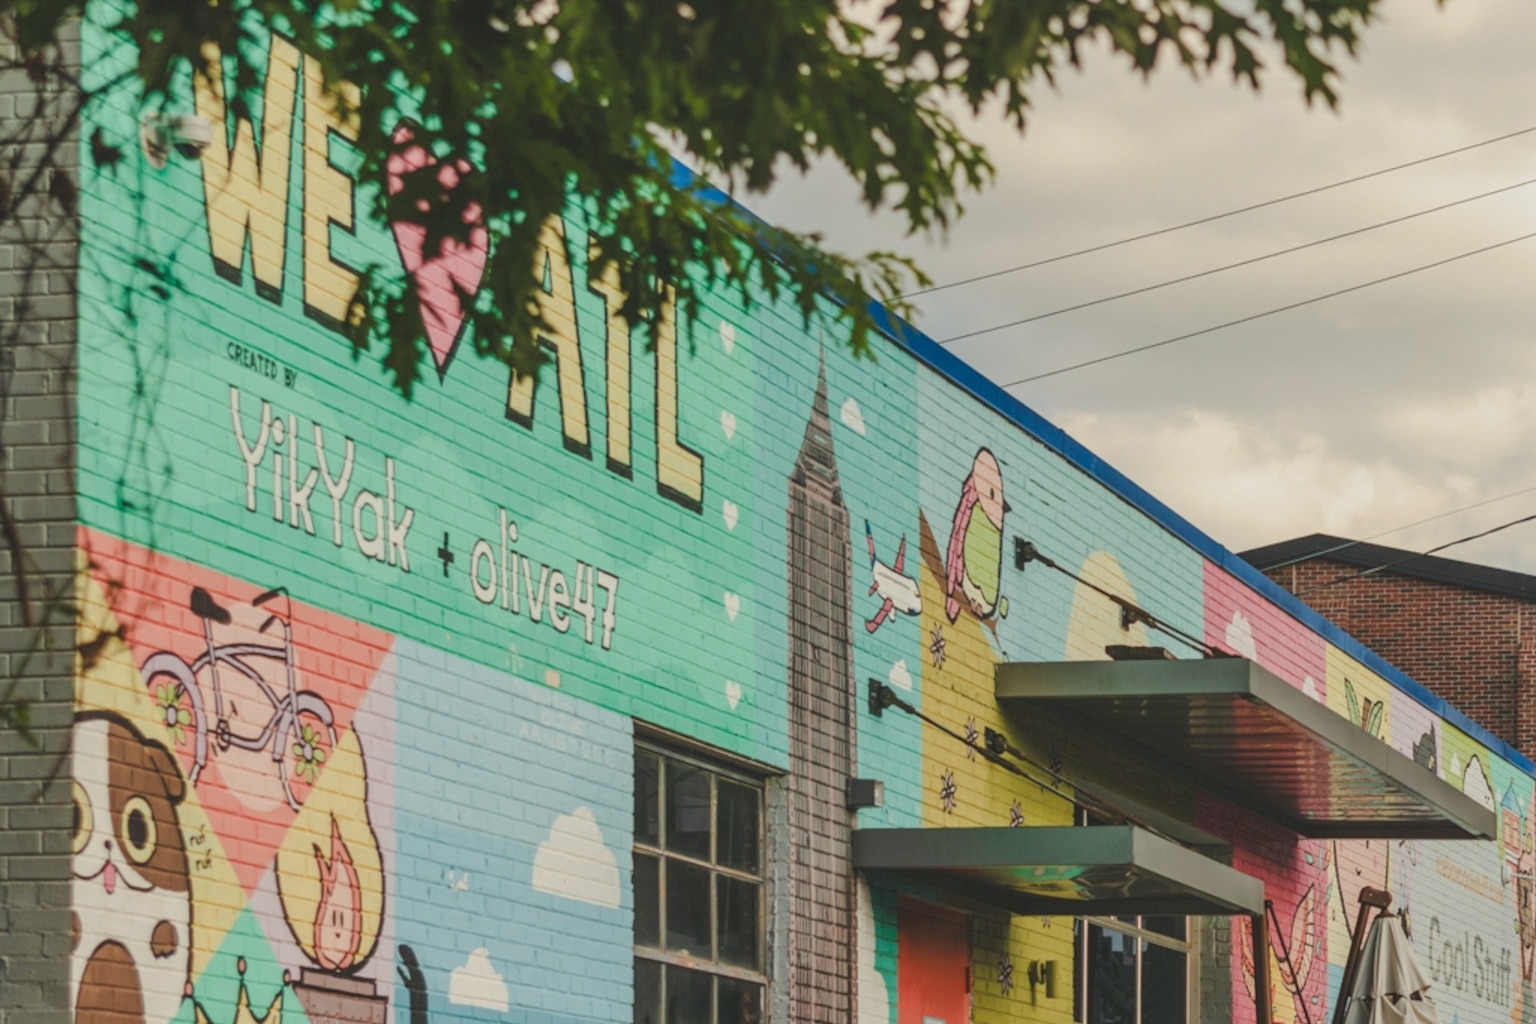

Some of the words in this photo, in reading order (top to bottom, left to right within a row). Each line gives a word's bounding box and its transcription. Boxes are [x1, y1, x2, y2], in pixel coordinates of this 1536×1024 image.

[192, 30, 363, 342] WE
[504, 207, 704, 516] ATL
[227, 342, 278, 381] CREATED
[284, 366, 298, 389] BY
[229, 384, 415, 574] YikYak
[470, 505, 620, 652] olive47
[1429, 914, 1468, 993] Cool
[1474, 934, 1511, 1008] Stuff
